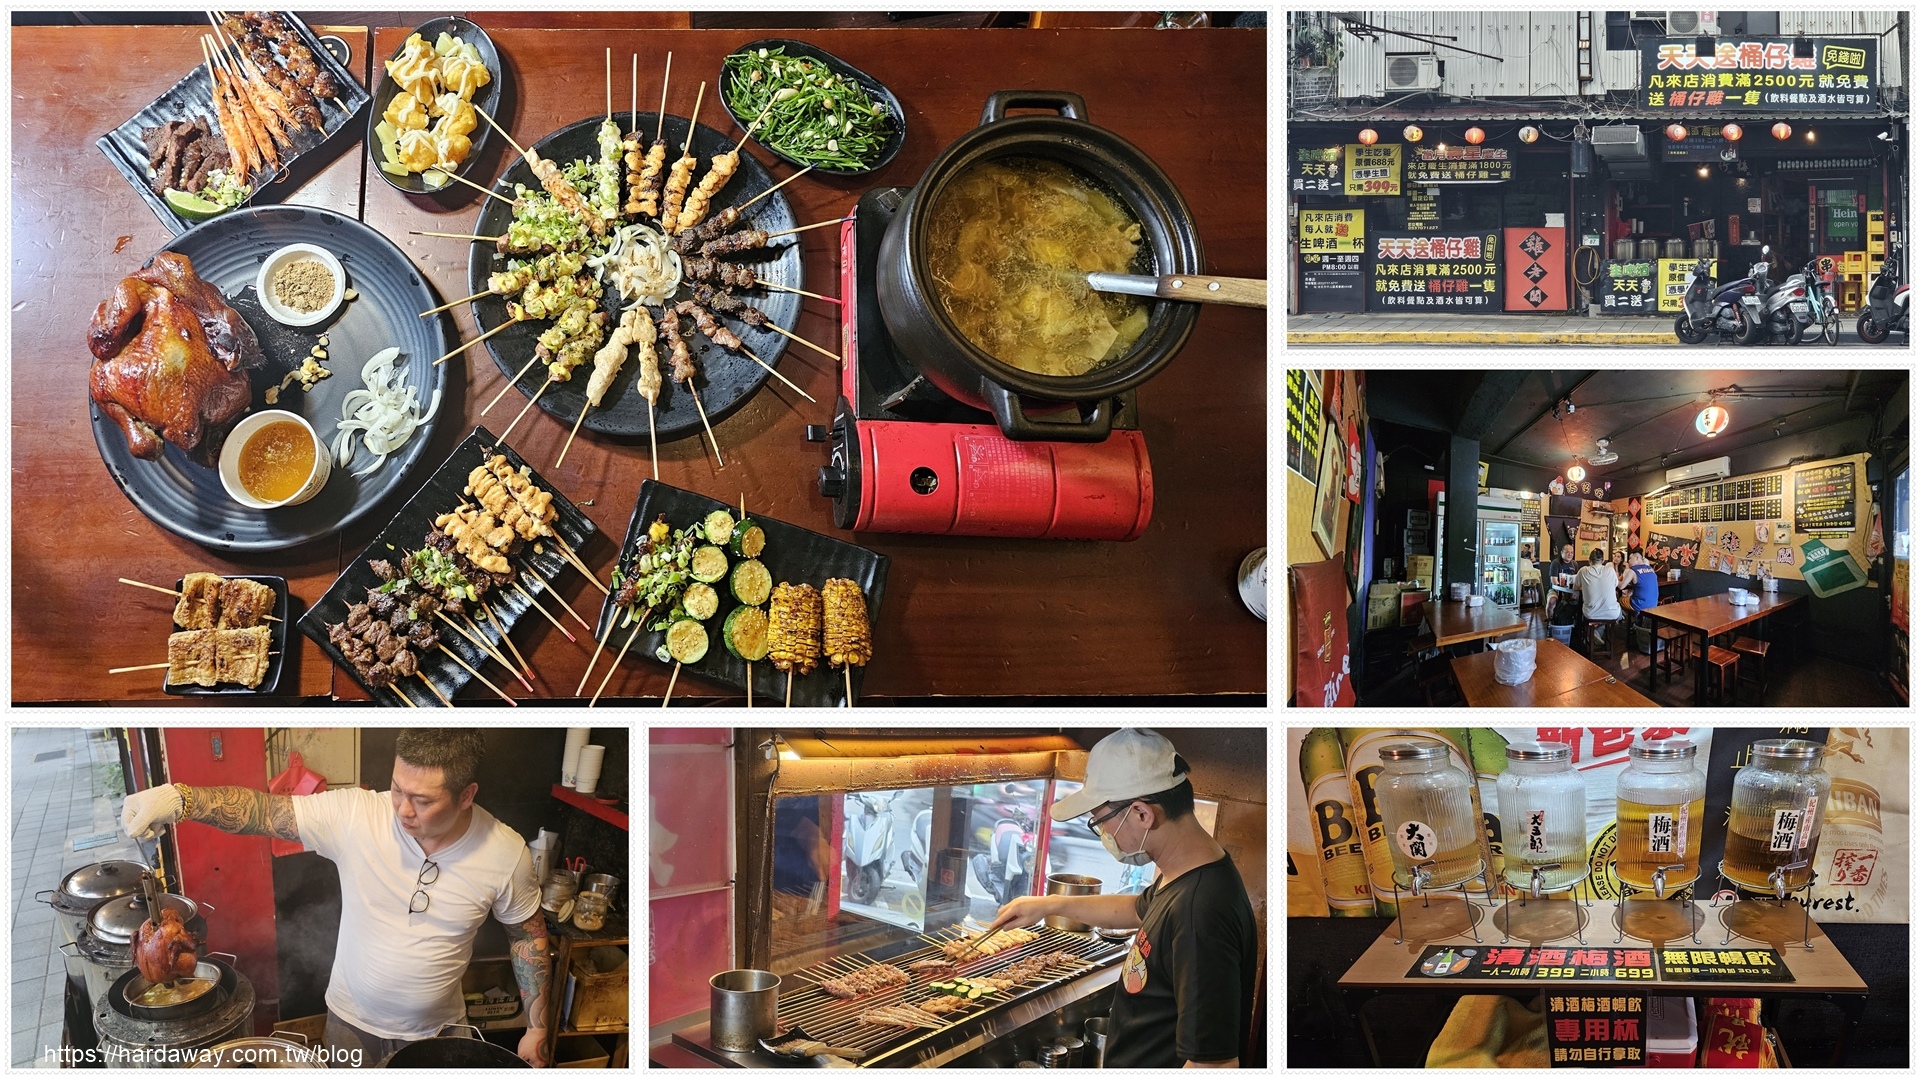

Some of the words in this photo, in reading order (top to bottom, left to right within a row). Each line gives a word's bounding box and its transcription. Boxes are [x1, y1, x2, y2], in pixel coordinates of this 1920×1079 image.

[1827, 49, 1862, 66] 免錢啦
[1298, 148, 1337, 161] 生啤酒
[1355, 158, 1395, 166] 原價688元
[1407, 161, 1511, 170] 來店慶生消費滿1800元
[1301, 163, 1326, 176] 天天
[1293, 179, 1342, 191] 買二送一
[1349, 180, 1398, 193] 只需399元
[1304, 213, 1353, 223] 凡來店消費
[1304, 223, 1349, 237] 每人就送
[1300, 237, 1365, 249] 生啤酒一杯
[1378, 237, 1481, 259] 天天送桶仔雞
[1375, 263, 1496, 276] 凡來店消費滿2500元
[1609, 263, 1650, 278] 生啤酒
[1375, 279, 1496, 293] 就免費送桶仔雞一隻
[1613, 280, 1639, 292] 天天
[1604, 295, 1656, 307] 買二送一
[1652, 816, 1672, 852] 梅酒
[1773, 811, 1799, 850] 梅酒
[1596, 875, 1612, 900] LEASE
[1482, 948, 1652, 967] 清酒梅酒
[1663, 950, 1777, 967] 無限暢飲
[1481, 967, 1530, 976] 一人一小時
[1536, 968, 1575, 978] 399
[1580, 968, 1609, 977] 二小時
[1615, 968, 1654, 978] 699
[1550, 997, 1642, 1013] 清酒梅酒暢飲
[1554, 1018, 1640, 1042] 專用杯
